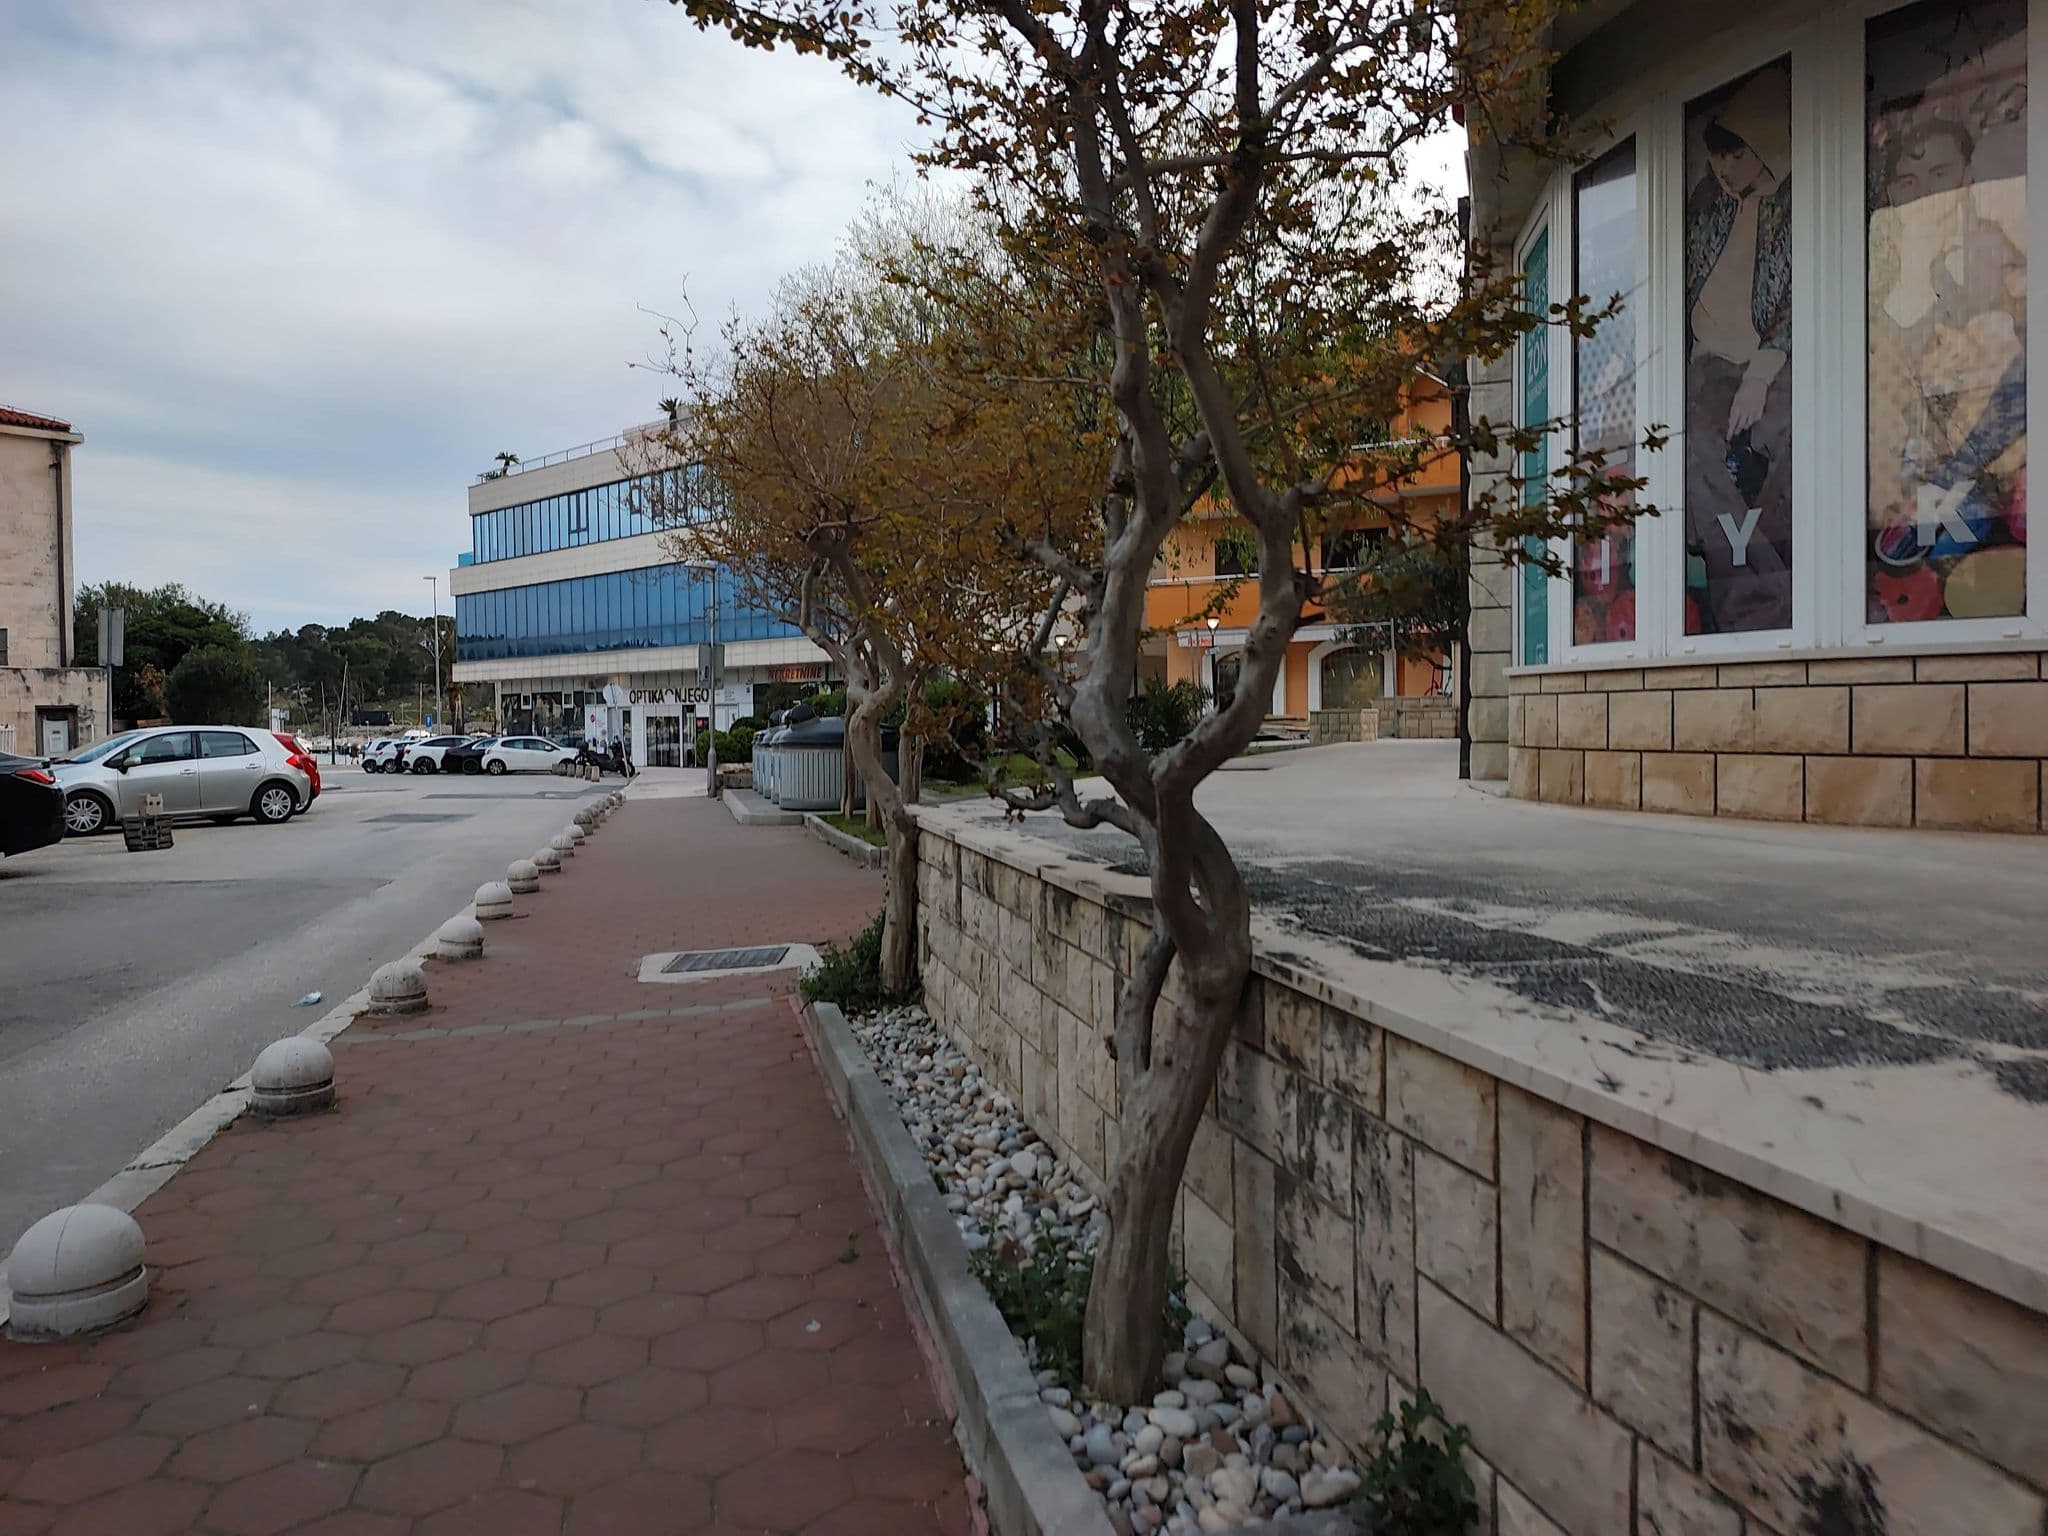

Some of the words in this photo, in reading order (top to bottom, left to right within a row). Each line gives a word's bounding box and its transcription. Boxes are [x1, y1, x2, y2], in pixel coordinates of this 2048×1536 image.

[1717, 508, 1763, 566] Y
[1916, 480, 1978, 547] K
[629, 689, 665, 704] OPTIKA
[674, 688, 710, 703] NJEGO
